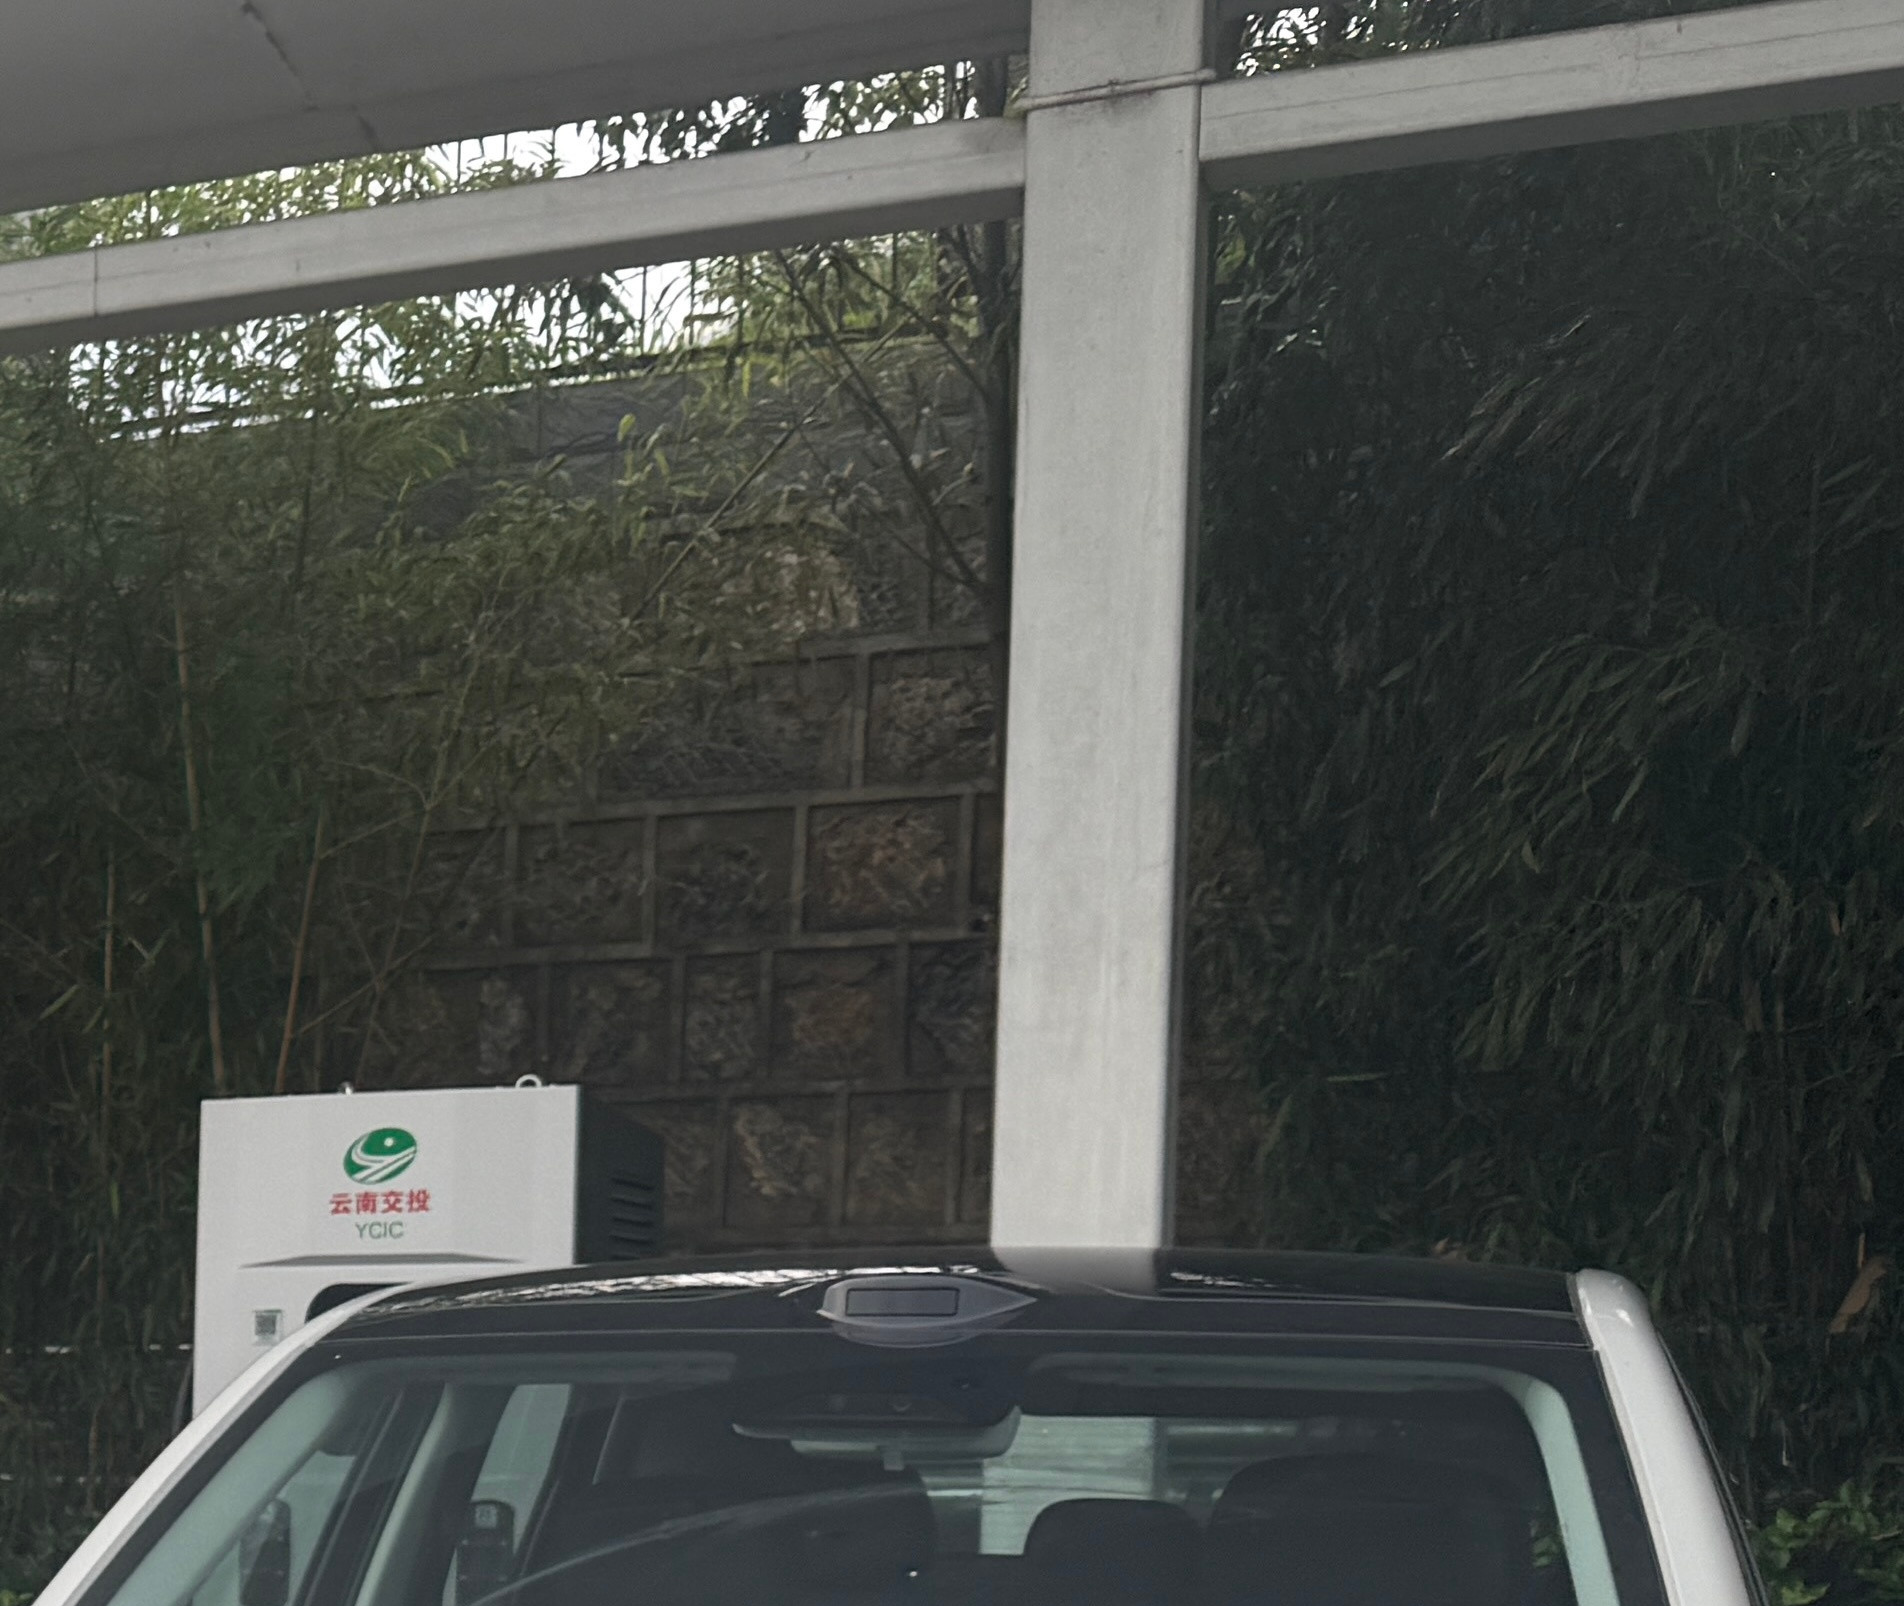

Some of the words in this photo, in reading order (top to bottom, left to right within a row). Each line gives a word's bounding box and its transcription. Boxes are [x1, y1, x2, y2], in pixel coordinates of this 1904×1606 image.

[329, 1188, 431, 1215] 云南交投
[355, 1221, 404, 1239] YCIC
